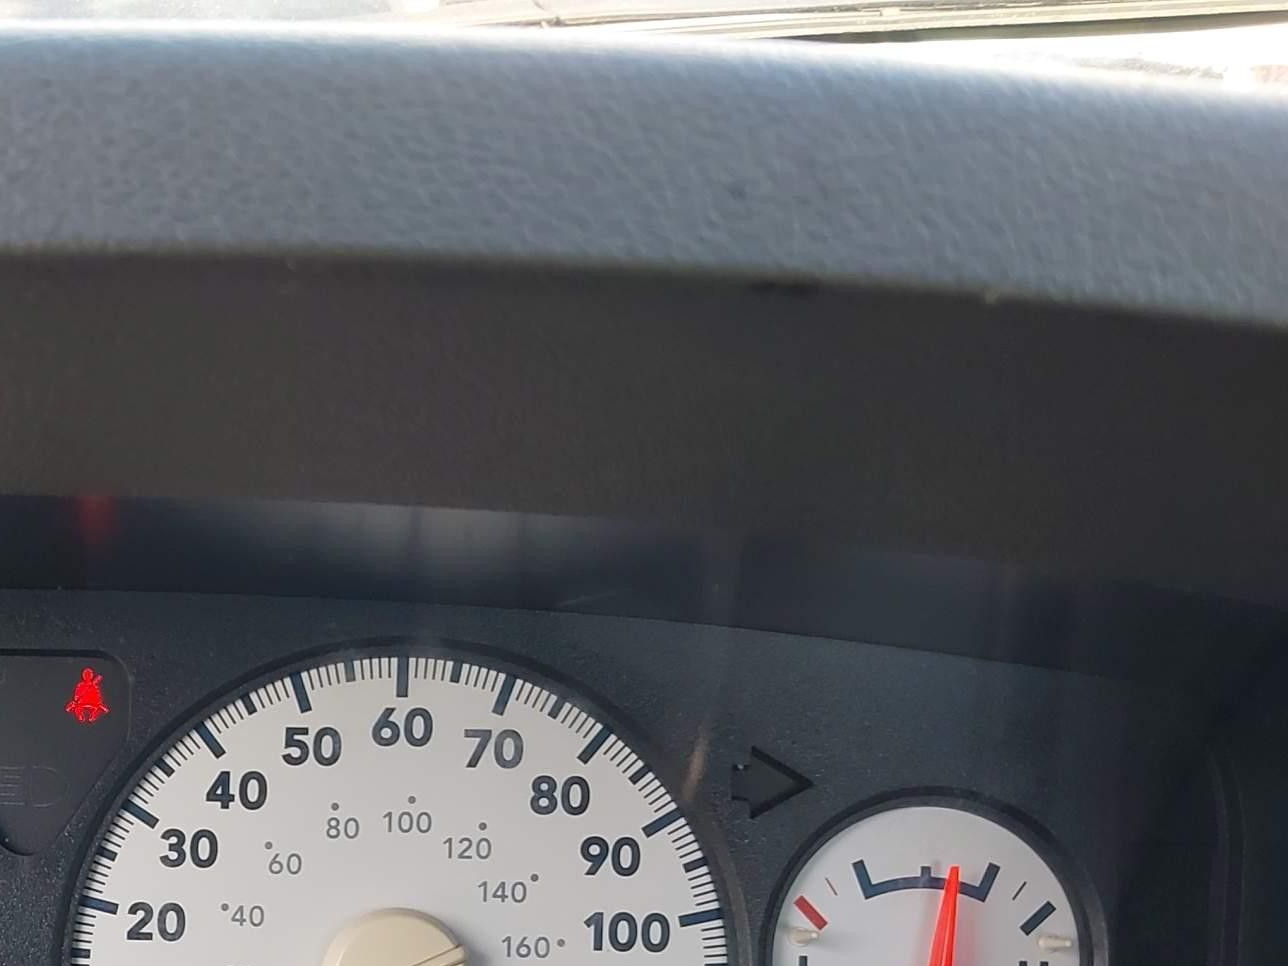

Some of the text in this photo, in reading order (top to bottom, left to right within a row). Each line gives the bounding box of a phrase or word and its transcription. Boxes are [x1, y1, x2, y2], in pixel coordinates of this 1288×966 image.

[281, 726, 342, 767] 50
[371, 707, 434, 748] 60
[463, 728, 524, 770] 70
[205, 770, 268, 811] 40
[529, 774, 591, 816] 80
[325, 816, 360, 840] 80
[382, 811, 433, 834] 100
[159, 828, 219, 869] 30
[268, 852, 303, 876] 60
[442, 837, 492, 860] 120
[580, 835, 641, 877] 90
[477, 880, 527, 904] 140
[126, 901, 186, 942] 20
[230, 904, 265, 928] 40
[583, 911, 671, 953] 100
[501, 935, 551, 959] 160
